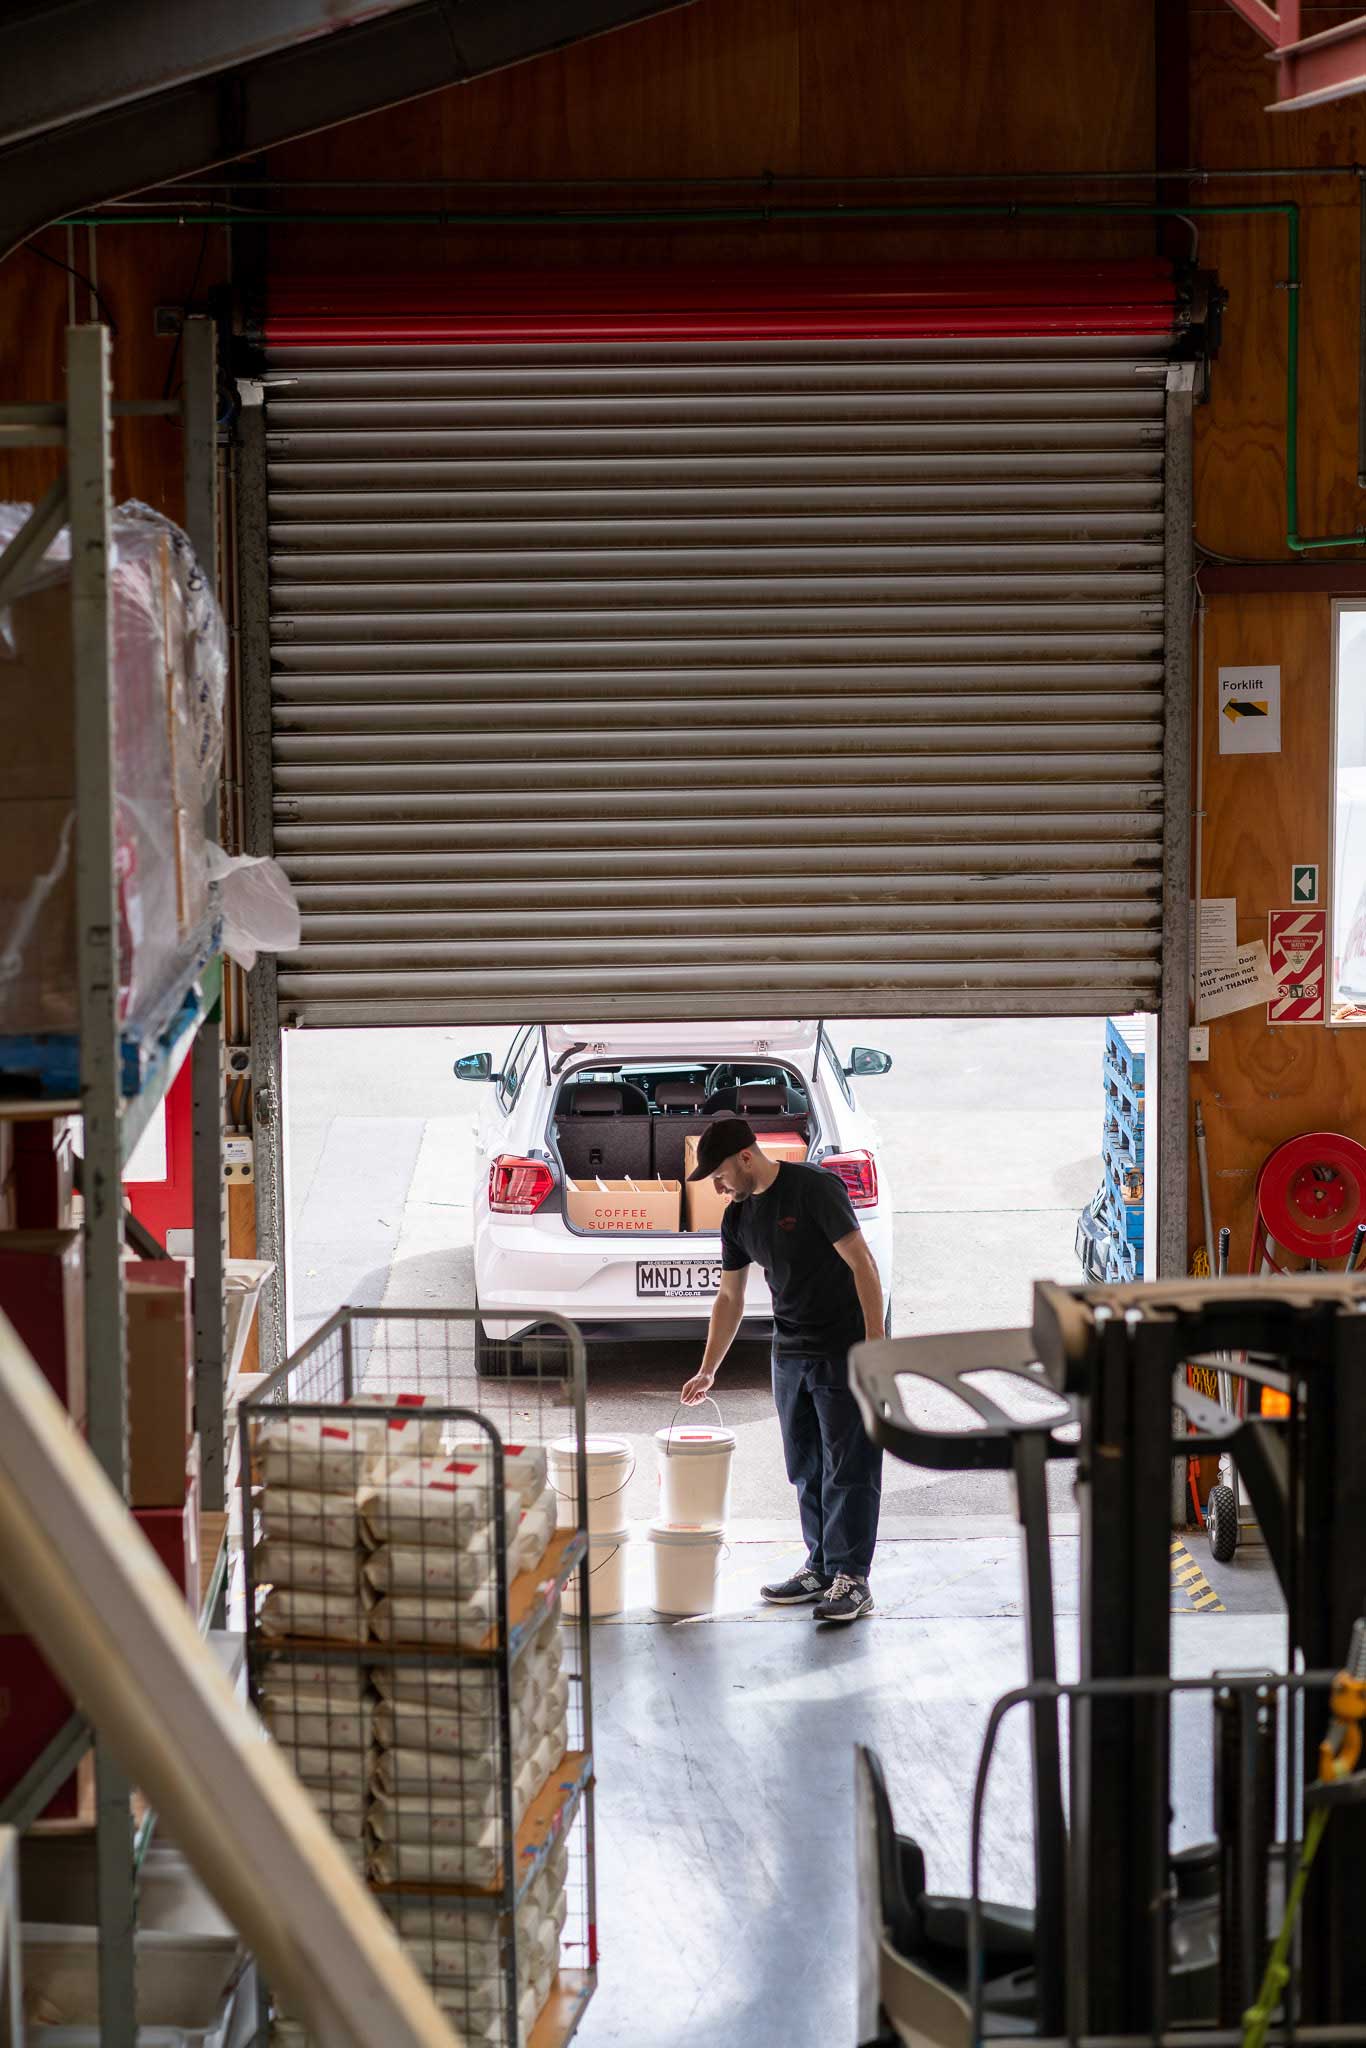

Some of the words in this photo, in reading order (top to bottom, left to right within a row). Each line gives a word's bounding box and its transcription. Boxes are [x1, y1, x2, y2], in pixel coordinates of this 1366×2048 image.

[1222, 679, 1264, 691] Forklift
[1238, 955, 1257, 965] Door
[1199, 977, 1217, 988] HUT
[1218, 971, 1240, 982] when
[1241, 966, 1255, 975] not
[1207, 986, 1224, 996] use!
[1224, 975, 1259, 990] THANKS
[594, 1209, 647, 1217] COFFEE
[588, 1221, 654, 1230] SUPREME
[641, 1267, 722, 1289] MND133
